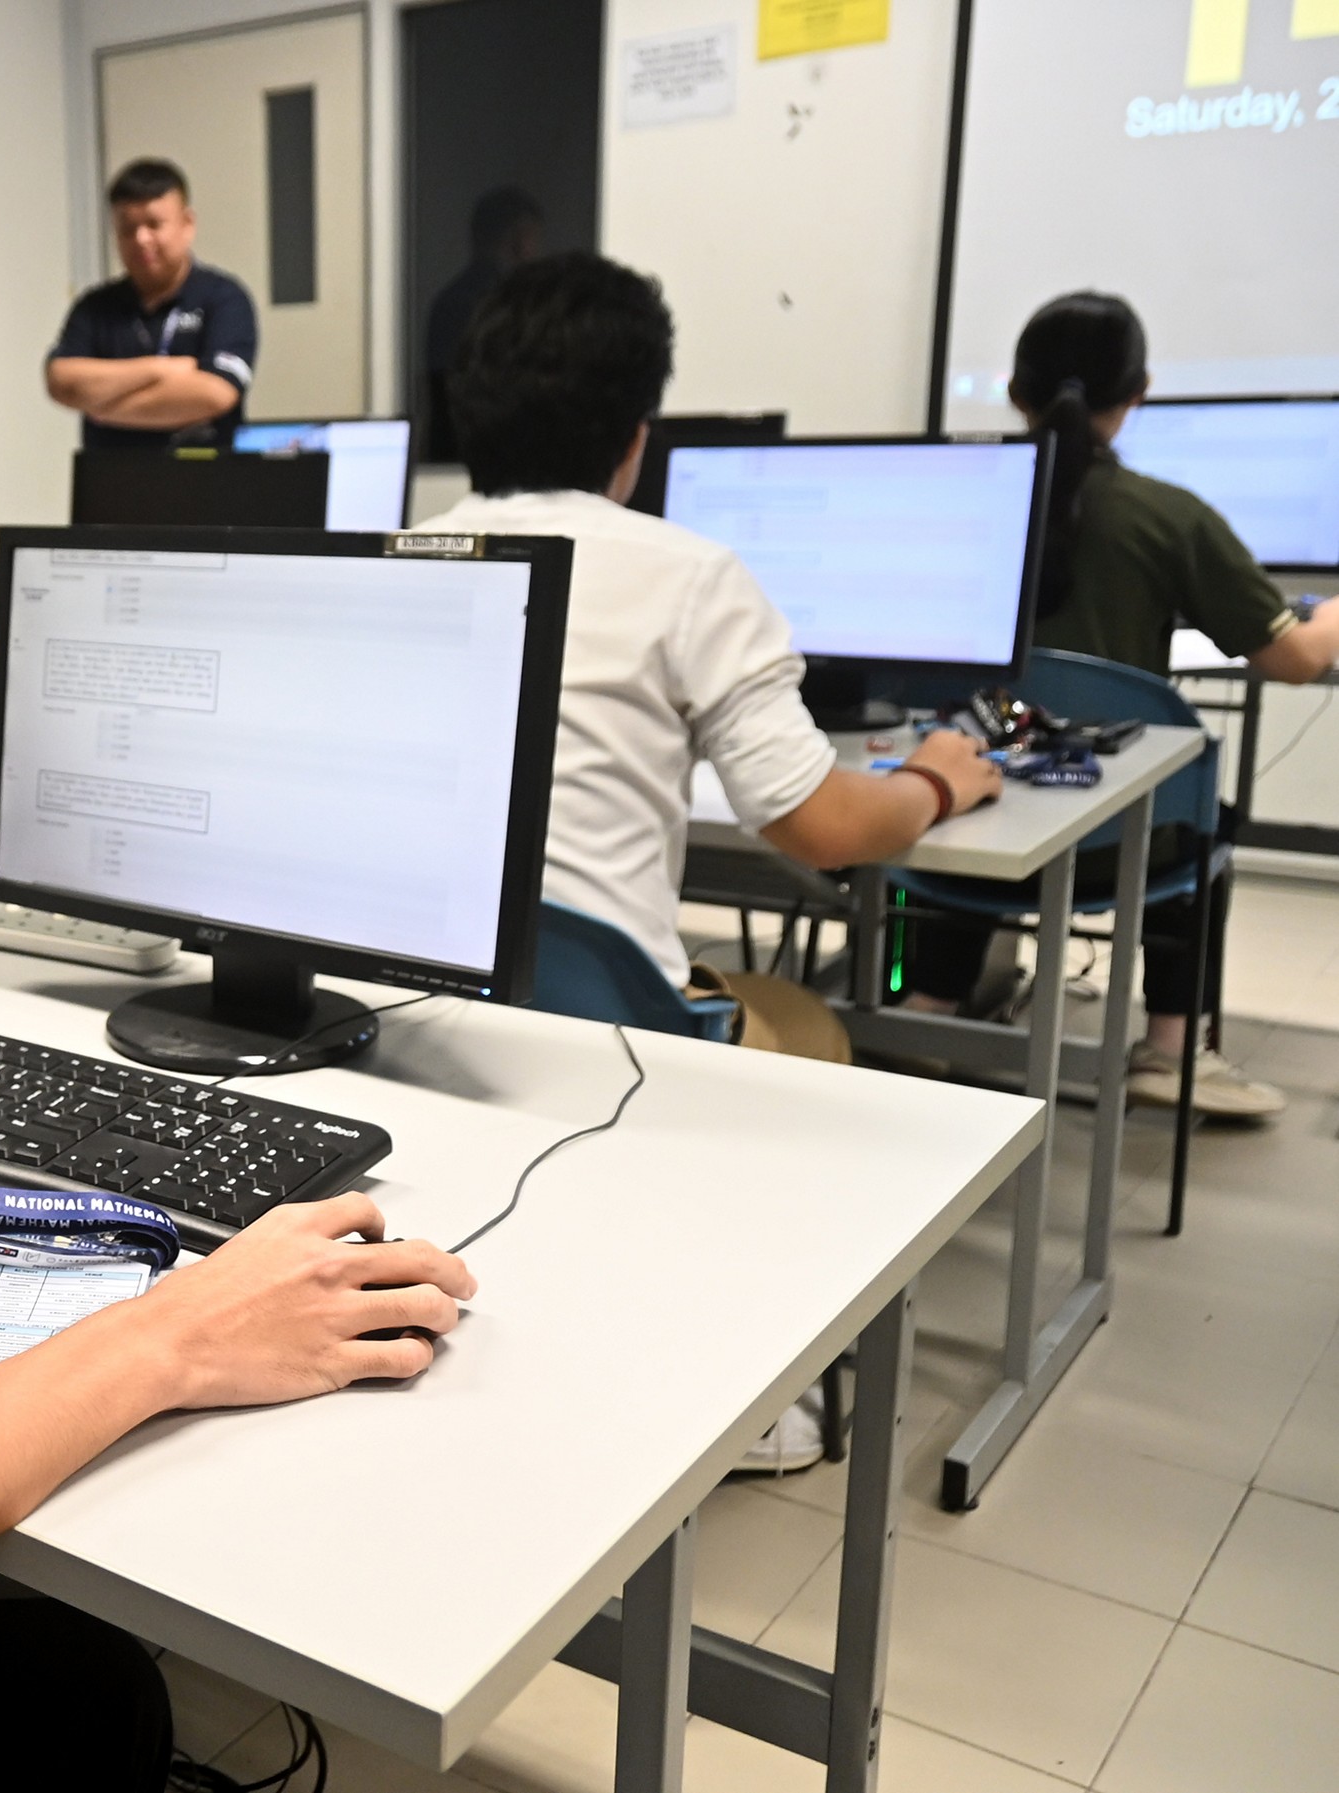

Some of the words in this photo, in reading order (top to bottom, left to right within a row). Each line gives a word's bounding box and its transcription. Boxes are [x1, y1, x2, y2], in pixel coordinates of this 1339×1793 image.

[1125, 85, 1305, 138] Saturday,
[313, 1121, 360, 1138] logitech
[5, 1195, 85, 1211] NATIONAL
